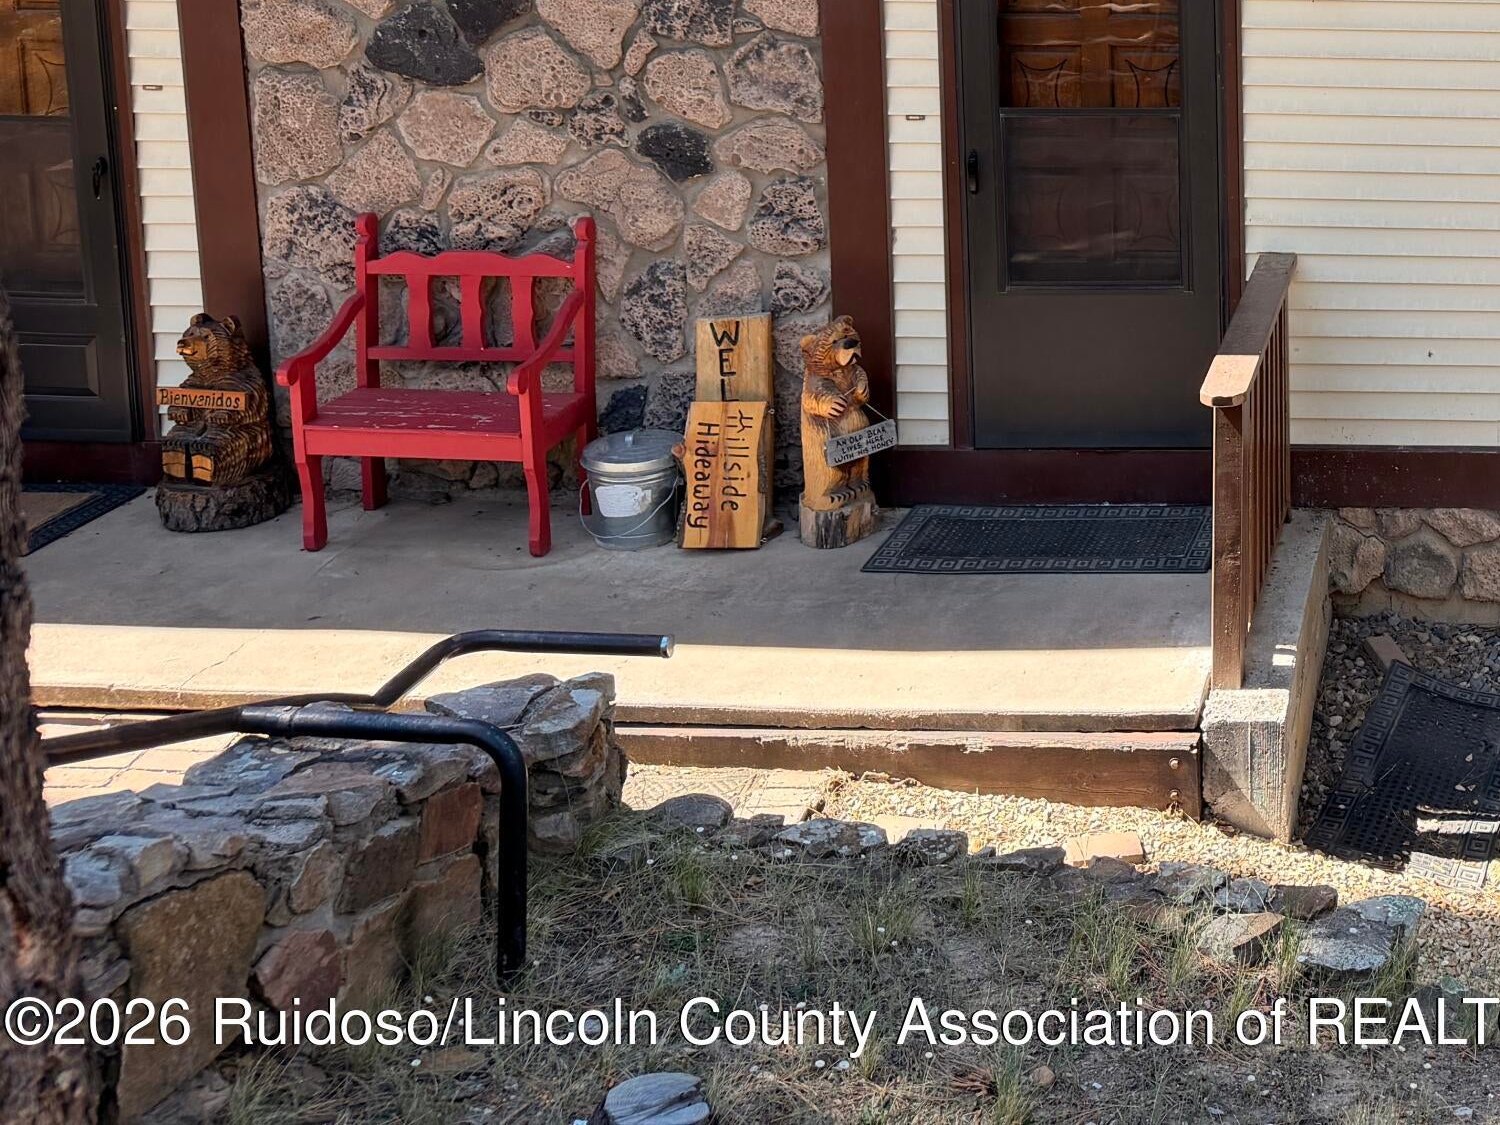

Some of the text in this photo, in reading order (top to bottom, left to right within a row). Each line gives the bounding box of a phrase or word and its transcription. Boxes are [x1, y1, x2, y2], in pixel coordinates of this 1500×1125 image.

[160, 389, 241, 409] Bienvenidos
[842, 435, 884, 454] LIVES HERE
[849, 434, 863, 444] OLD
[867, 426, 887, 438] BEAR
[721, 409, 754, 511] Hillside
[834, 453, 854, 463] WITH
[871, 437, 894, 451] HONEY
[687, 422, 720, 528] Hideaway
